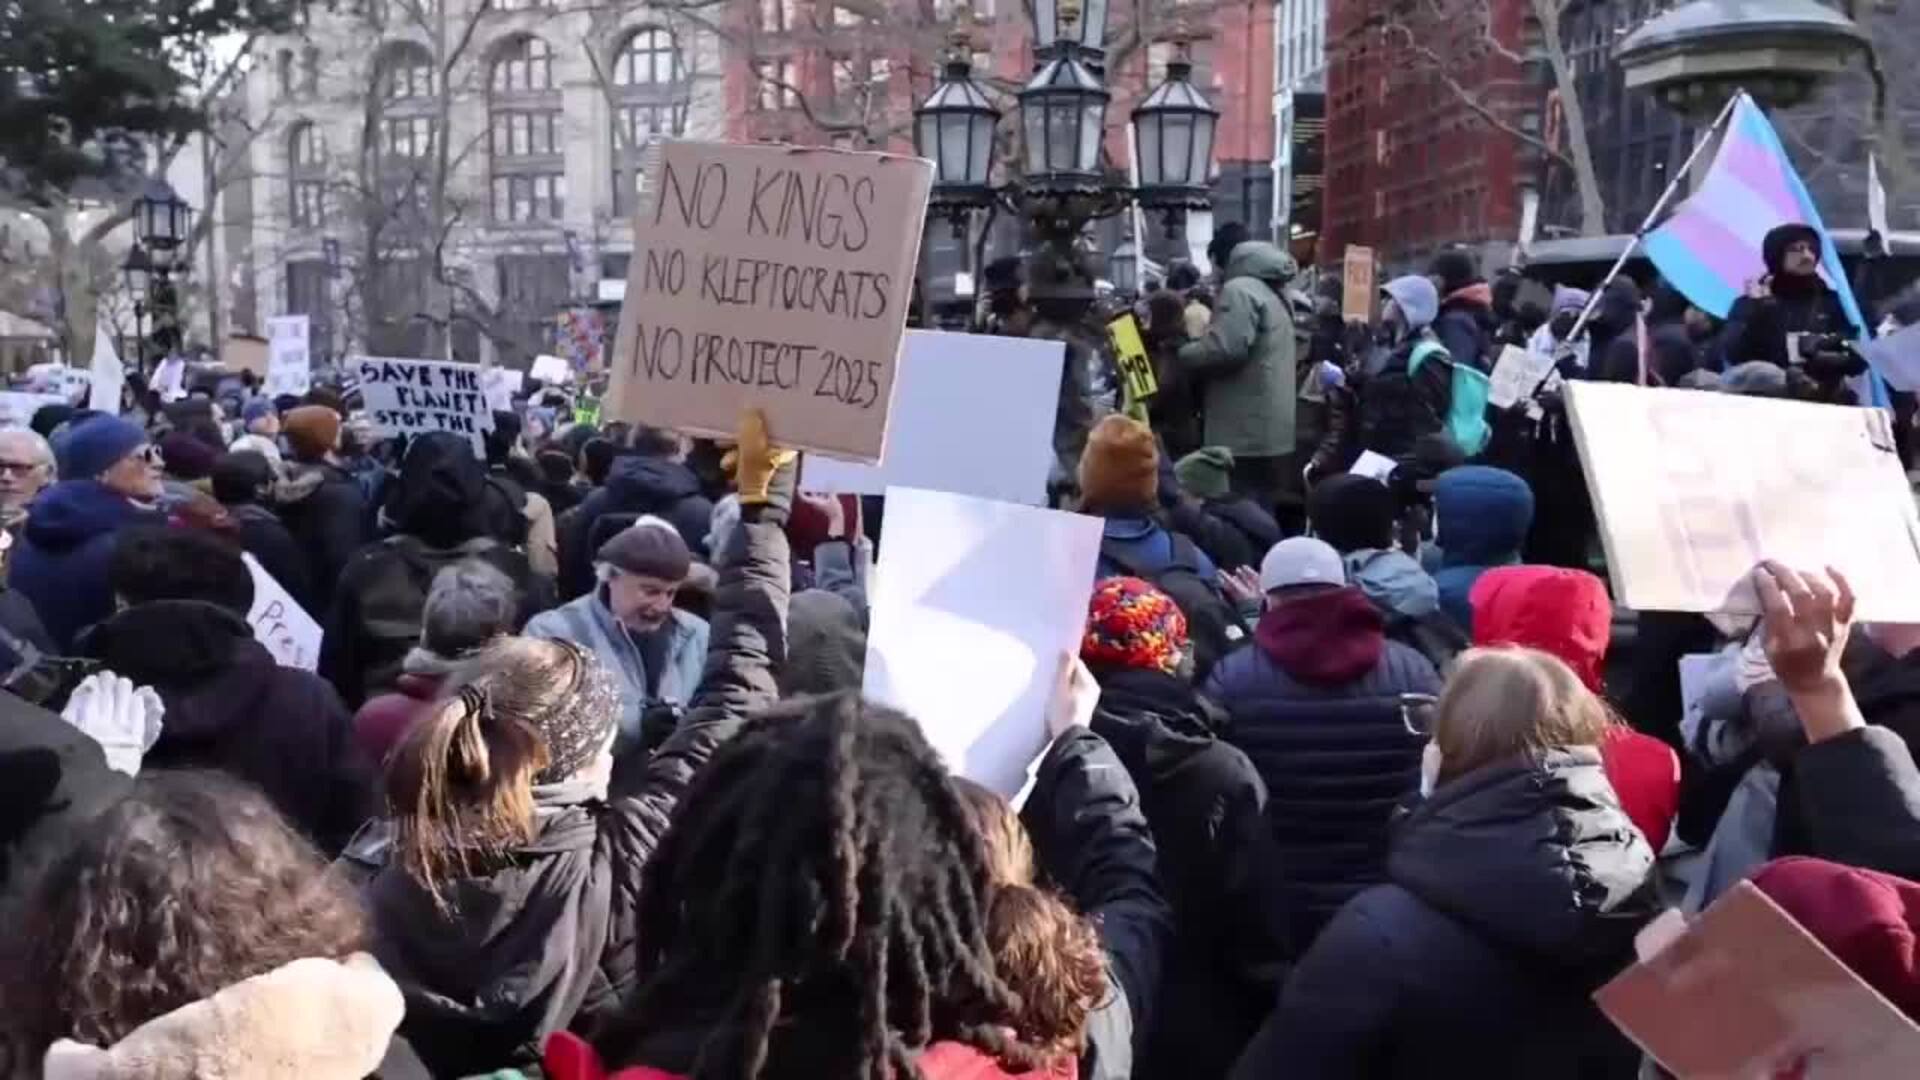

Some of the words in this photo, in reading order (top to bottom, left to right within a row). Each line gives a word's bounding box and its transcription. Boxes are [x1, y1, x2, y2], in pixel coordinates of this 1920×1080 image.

[655, 159, 728, 230] NO
[747, 166, 875, 252] KINGS
[644, 248, 685, 296] NO
[701, 254, 893, 320] KLEPTOCRATS
[360, 361, 433, 387] SAVE
[439, 366, 479, 391] THE
[632, 323, 683, 380] NO
[690, 334, 817, 390] PROJECT
[813, 350, 882, 409] 2025
[374, 409, 427, 428] STOP
[433, 412, 475, 434] THE
[396, 386, 488, 415] PLANET!
